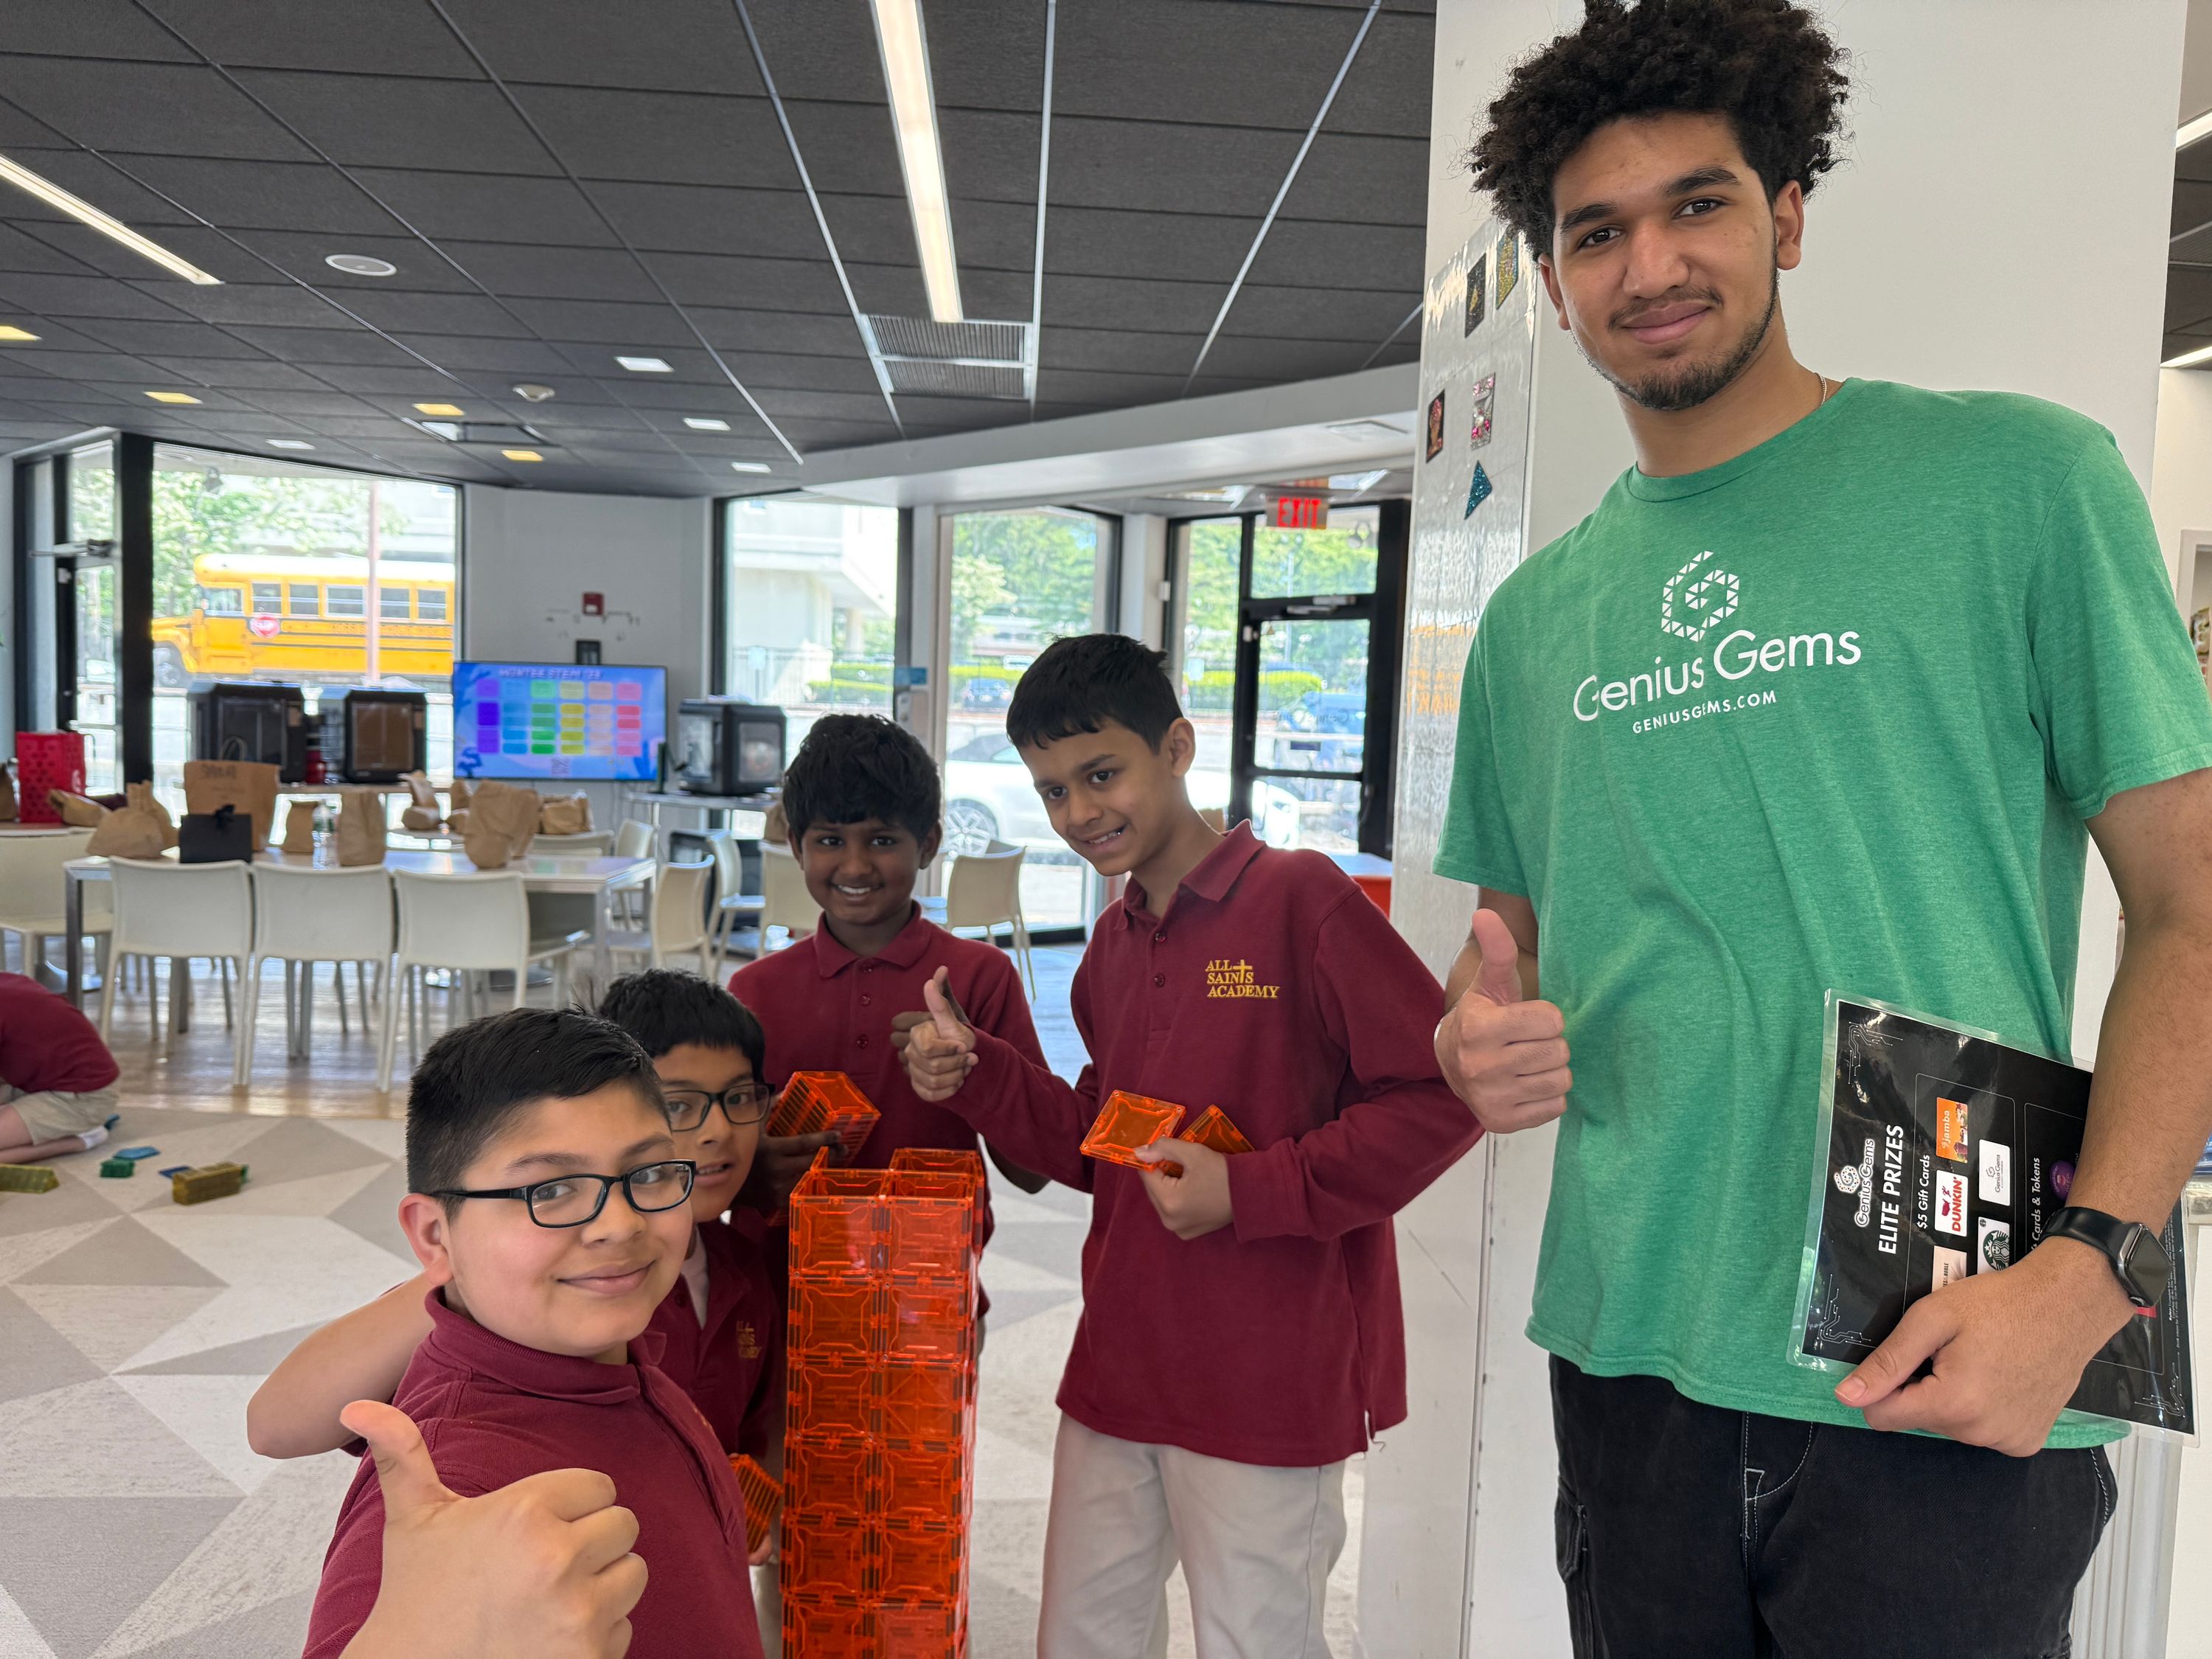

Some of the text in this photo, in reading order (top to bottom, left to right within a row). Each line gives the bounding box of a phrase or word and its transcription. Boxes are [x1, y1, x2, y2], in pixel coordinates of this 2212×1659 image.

[1277, 496, 1321, 529] EXIT
[1573, 630, 1862, 722] Genius Gems
[1632, 690, 1776, 734] GENIUSGEMS.COM
[1205, 960, 1232, 971] ALL
[1207, 985, 1280, 998] ACADEMY
[1943, 1110, 1951, 1143] jamba
[1854, 1139, 1874, 1227] Genius Gems
[1878, 1124, 1904, 1254] ELITE PRIZES
[1917, 1155, 1930, 1229] $5 Gift Cards
[2031, 1158, 2040, 1193] Tokens
[1952, 1176, 1963, 1232] DUNKIN'
[2032, 1197, 2040, 1206] &
[2031, 1209, 2040, 1241] Cards
